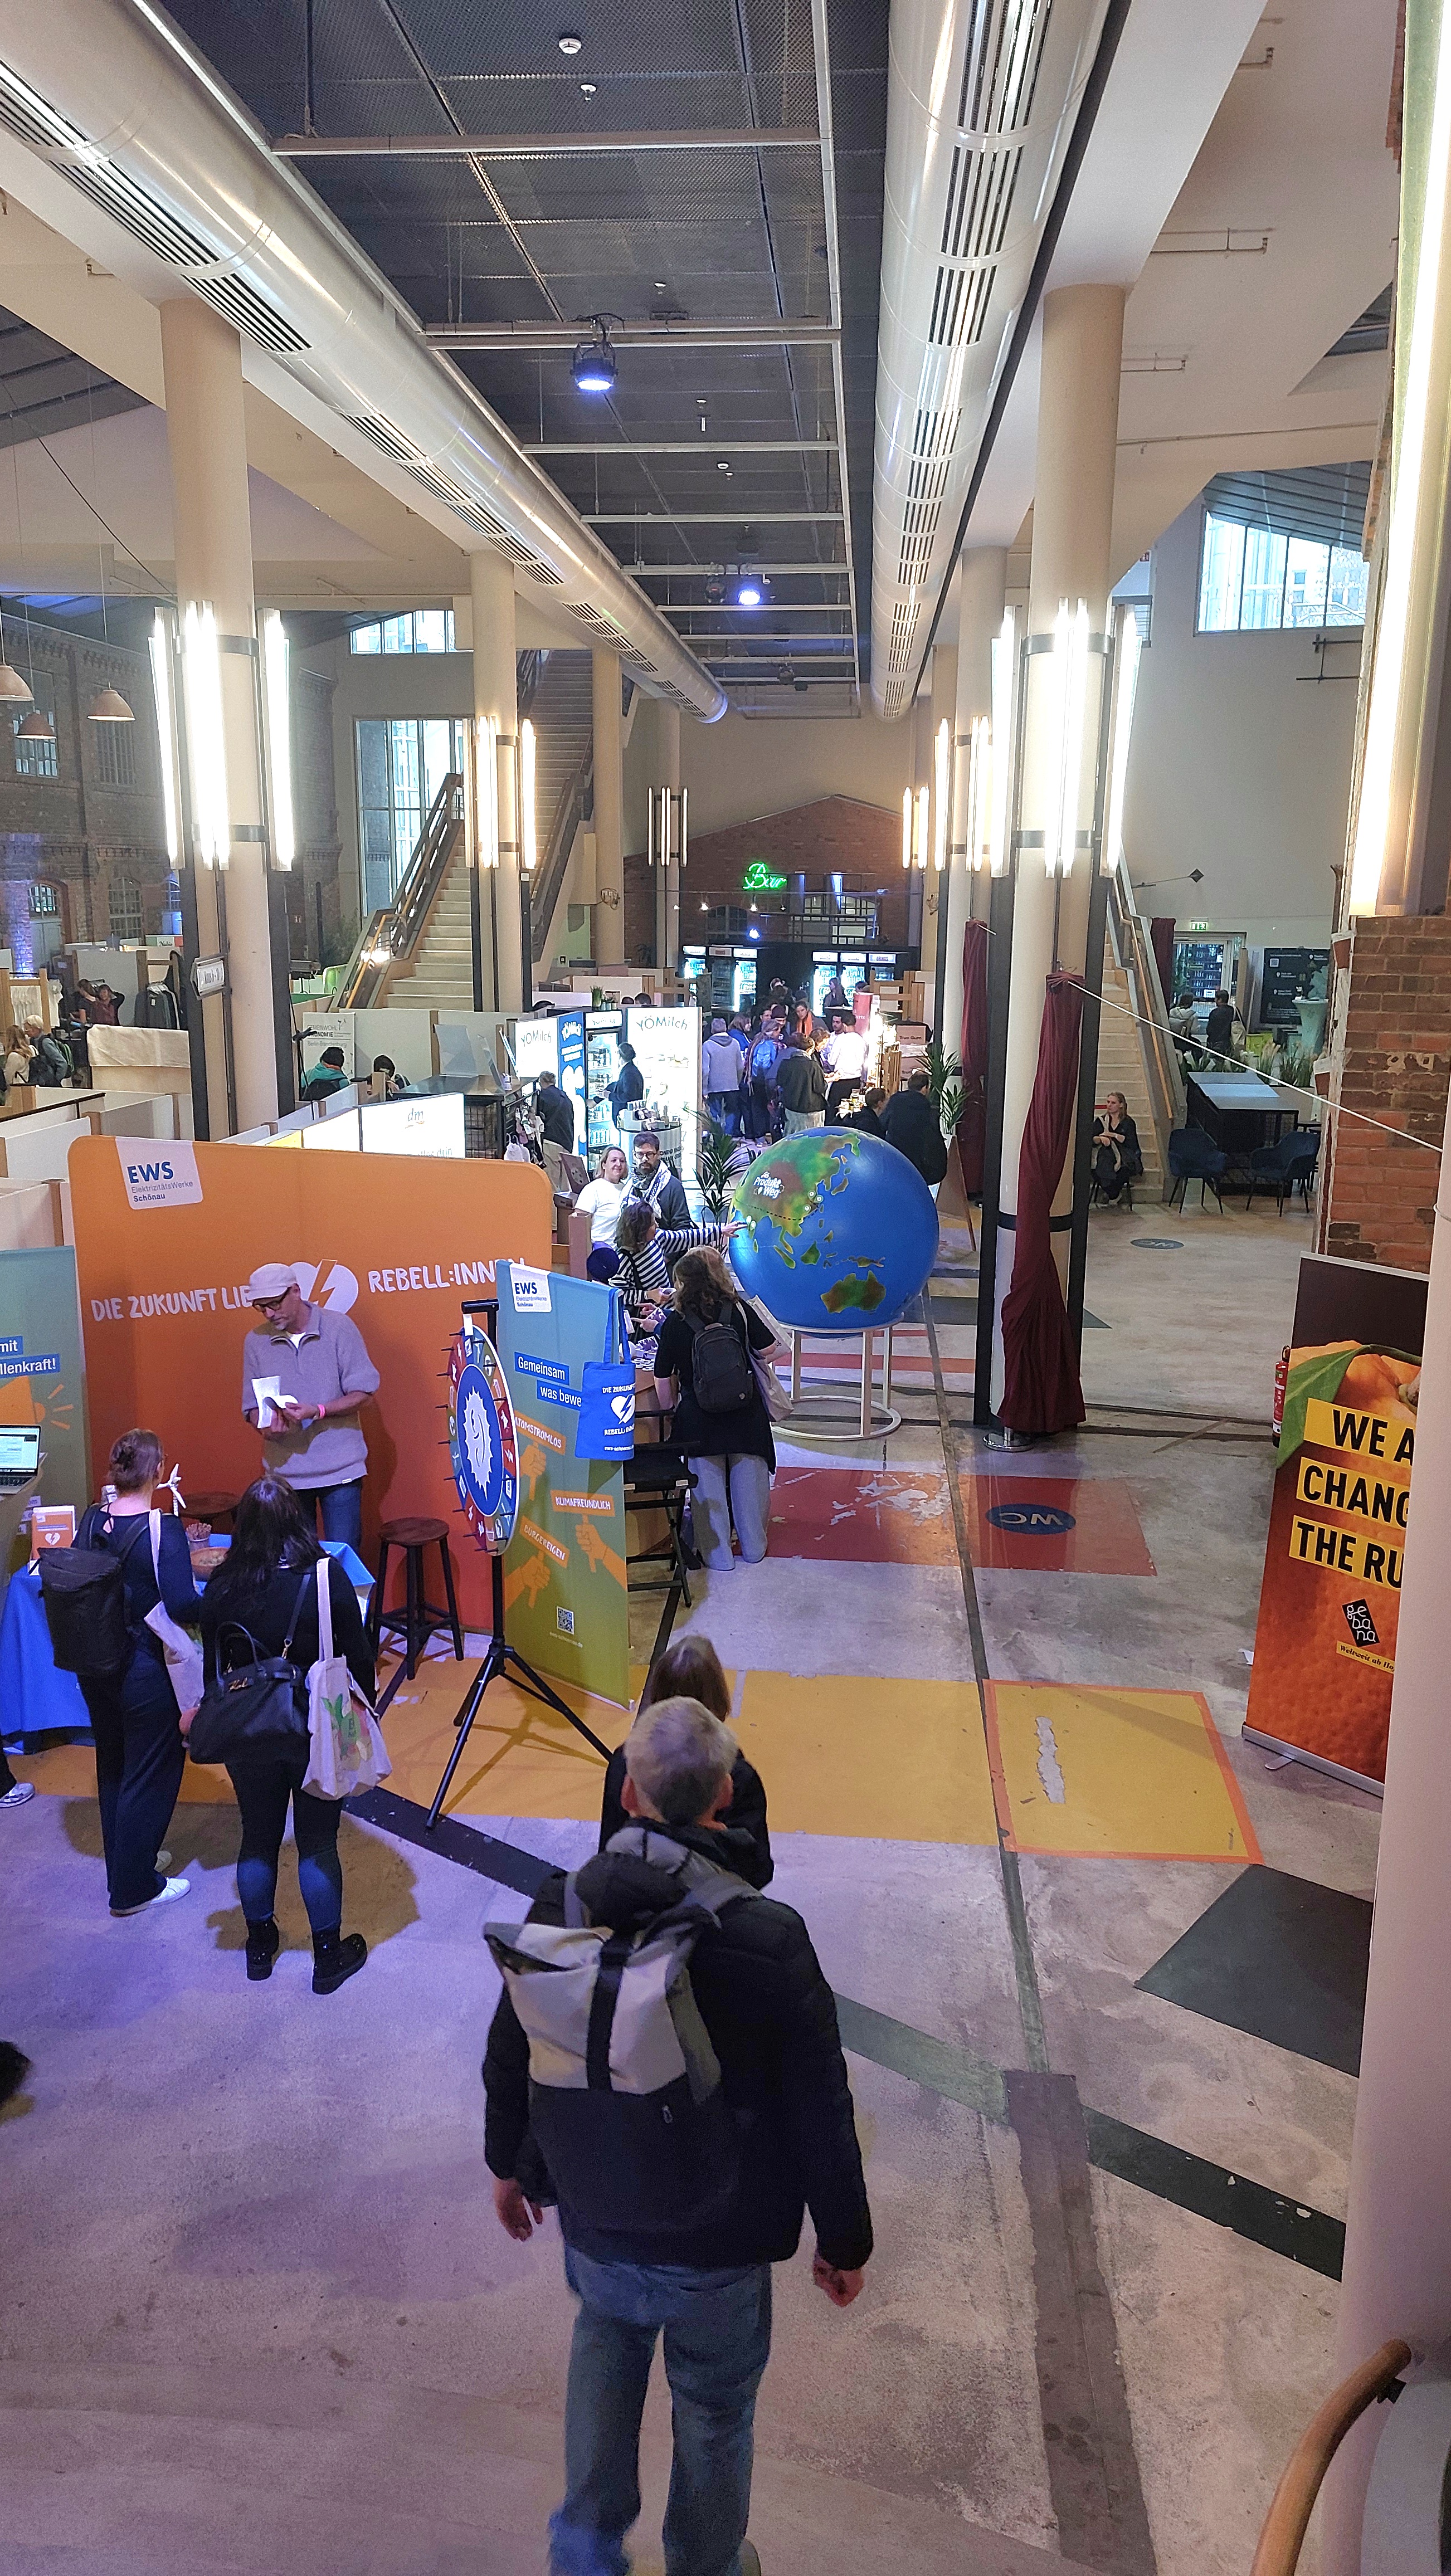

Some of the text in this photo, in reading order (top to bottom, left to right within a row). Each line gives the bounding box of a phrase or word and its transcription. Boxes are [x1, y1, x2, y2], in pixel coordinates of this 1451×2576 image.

[742, 863, 787, 889] Bar
[636, 1015, 688, 1031] YÖMilch
[407, 1108, 423, 1122] dm
[127, 1162, 174, 1183] EWS
[131, 1181, 193, 1193] ElektrizitätsWerke
[753, 1177, 781, 1189] Produkt
[133, 1193, 165, 1202] Schönau
[763, 1185, 780, 1199] Weg
[91, 1257, 524, 1321] DIE ZUKUNFT LIE REBELL:INN
[514, 1282, 538, 1294] EWS
[0, 1358, 56, 1375] llenkraft!
[518, 1357, 566, 1380] Gemeinsam
[540, 1387, 582, 1407] was bewe
[1332, 1409, 1415, 1466] WE A
[555, 1496, 611, 1510] KLIMAFREUNDLICH
[1303, 1465, 1410, 1528] CHANG
[1000, 1513, 1064, 1526] WC
[1297, 1521, 1405, 1589] THE RU
[1340, 1645, 1370, 1661] Weltweit
